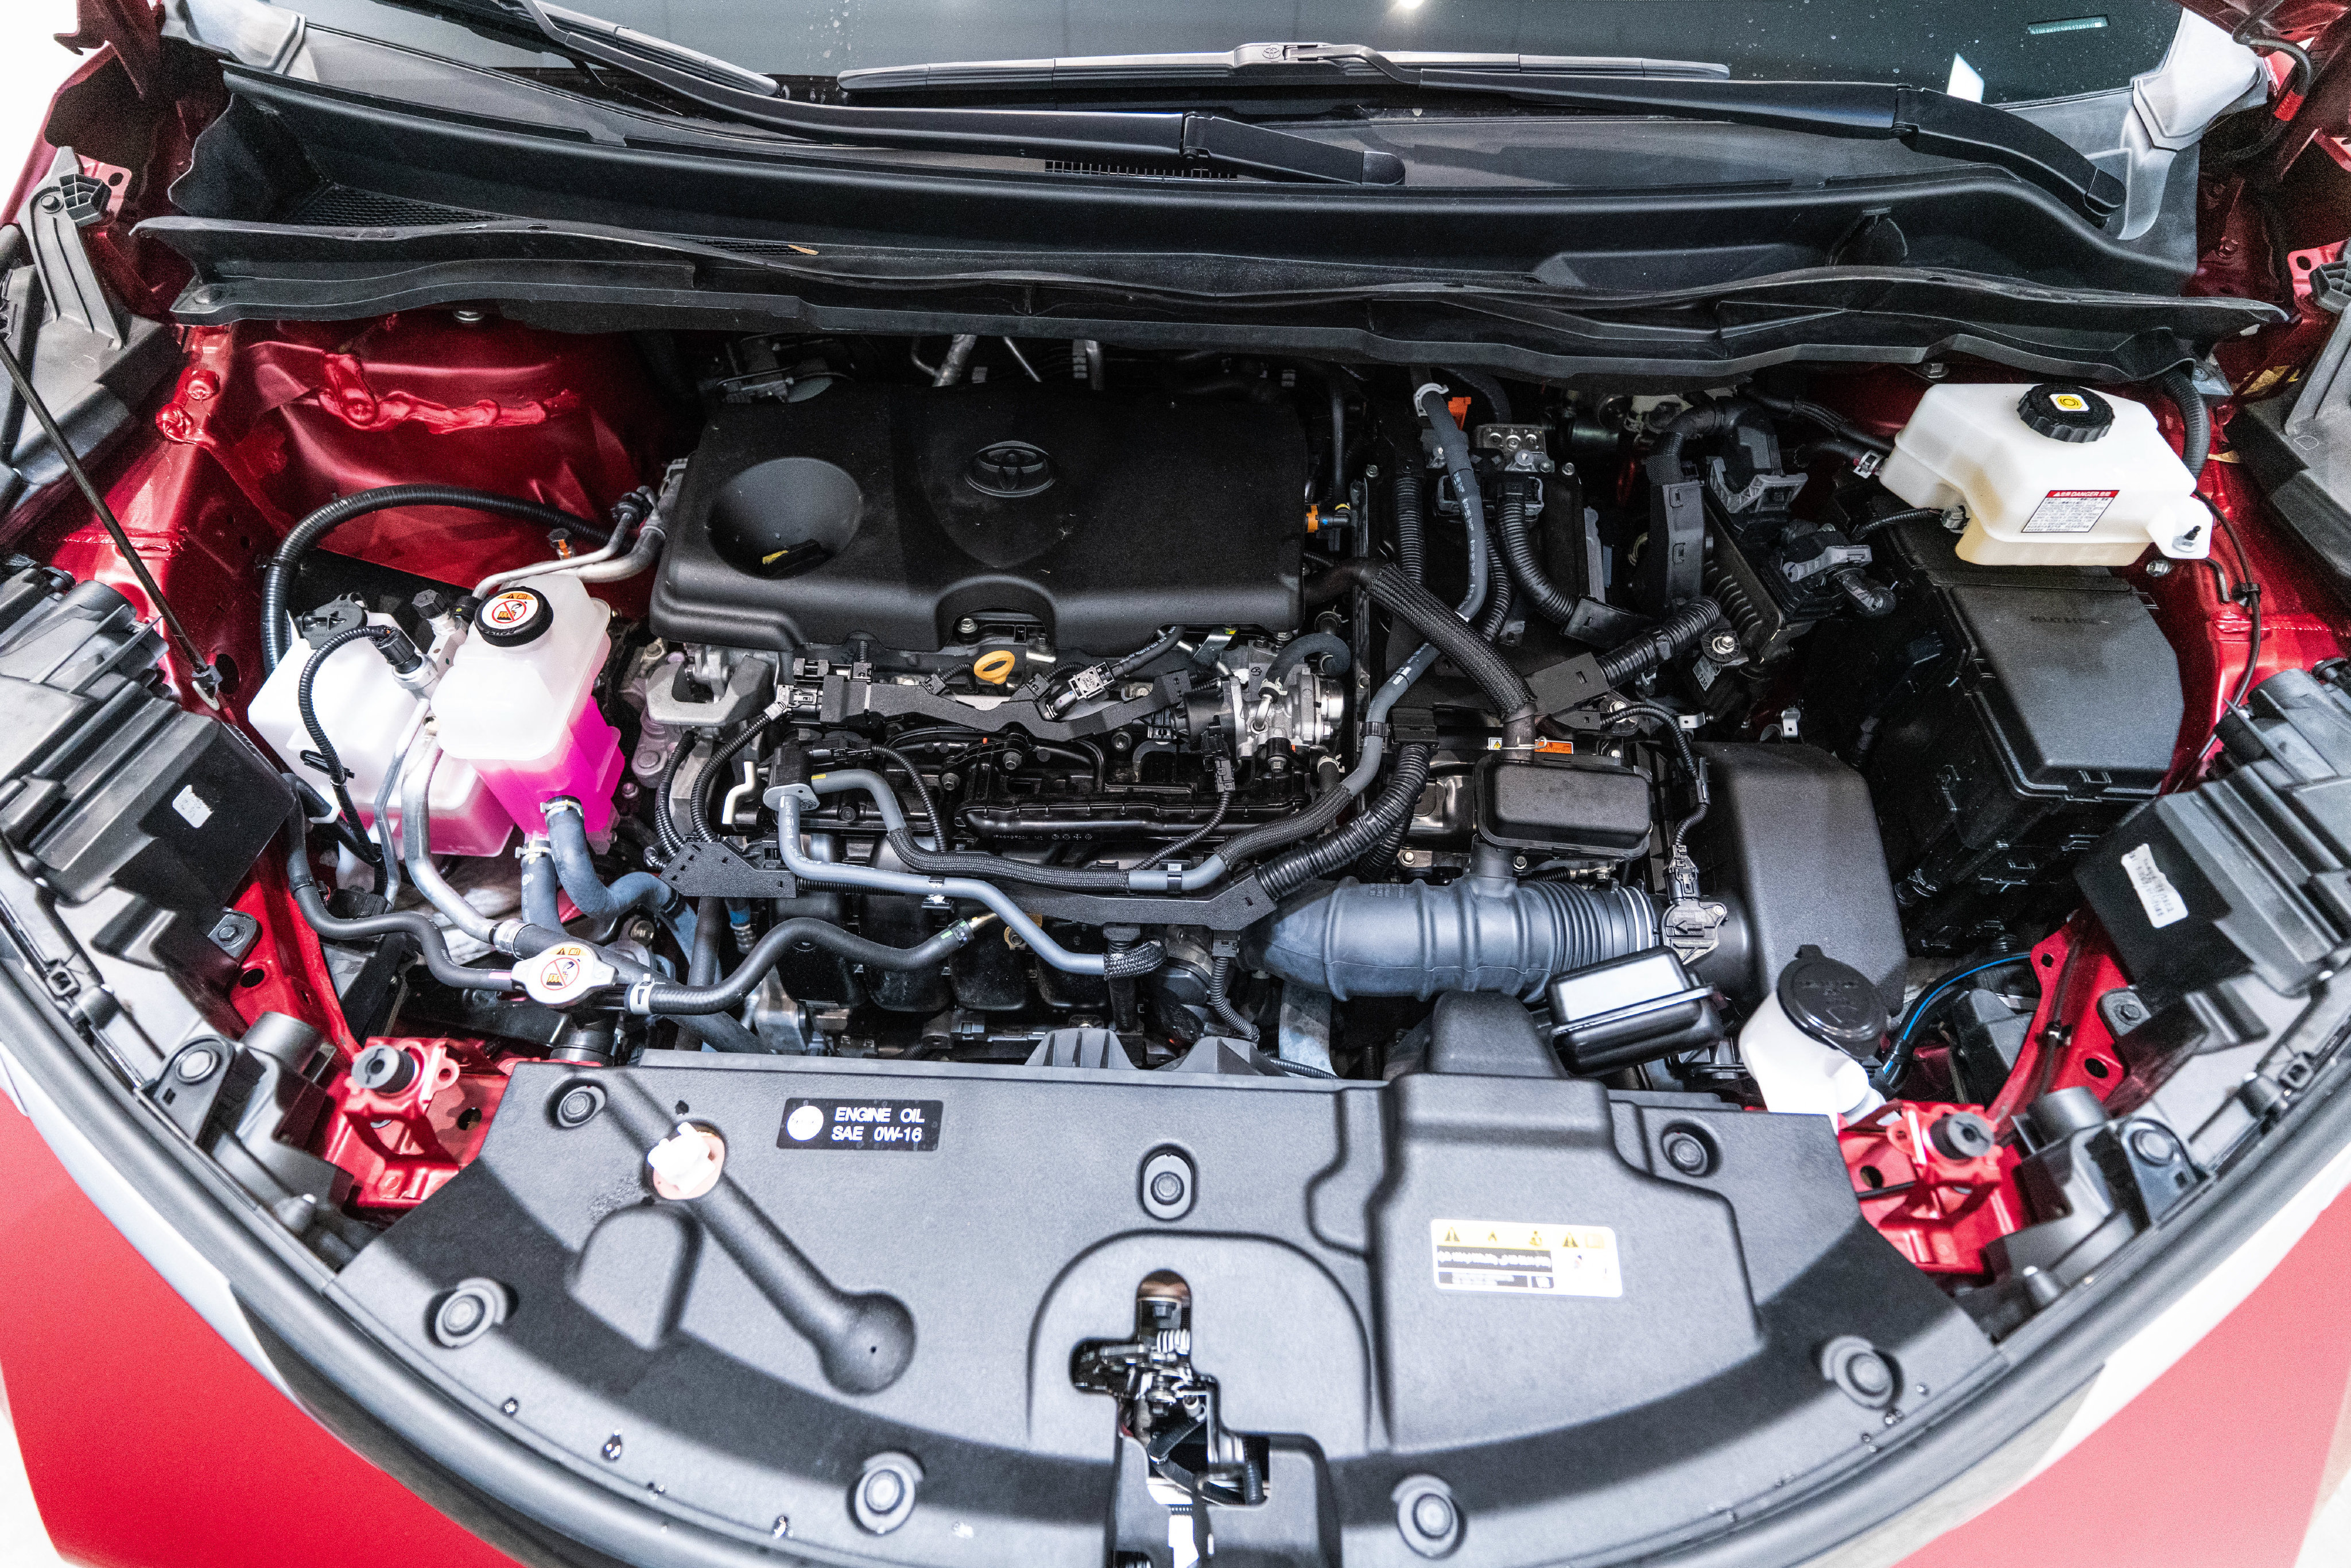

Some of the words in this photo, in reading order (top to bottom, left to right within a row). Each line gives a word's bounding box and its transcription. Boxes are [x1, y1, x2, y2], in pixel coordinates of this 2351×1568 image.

[835, 1107, 891, 1123] ENGINE
[899, 1108, 925, 1124] OIL
[831, 1125, 864, 1141] SAE
[874, 1127, 922, 1142] 0W-16
